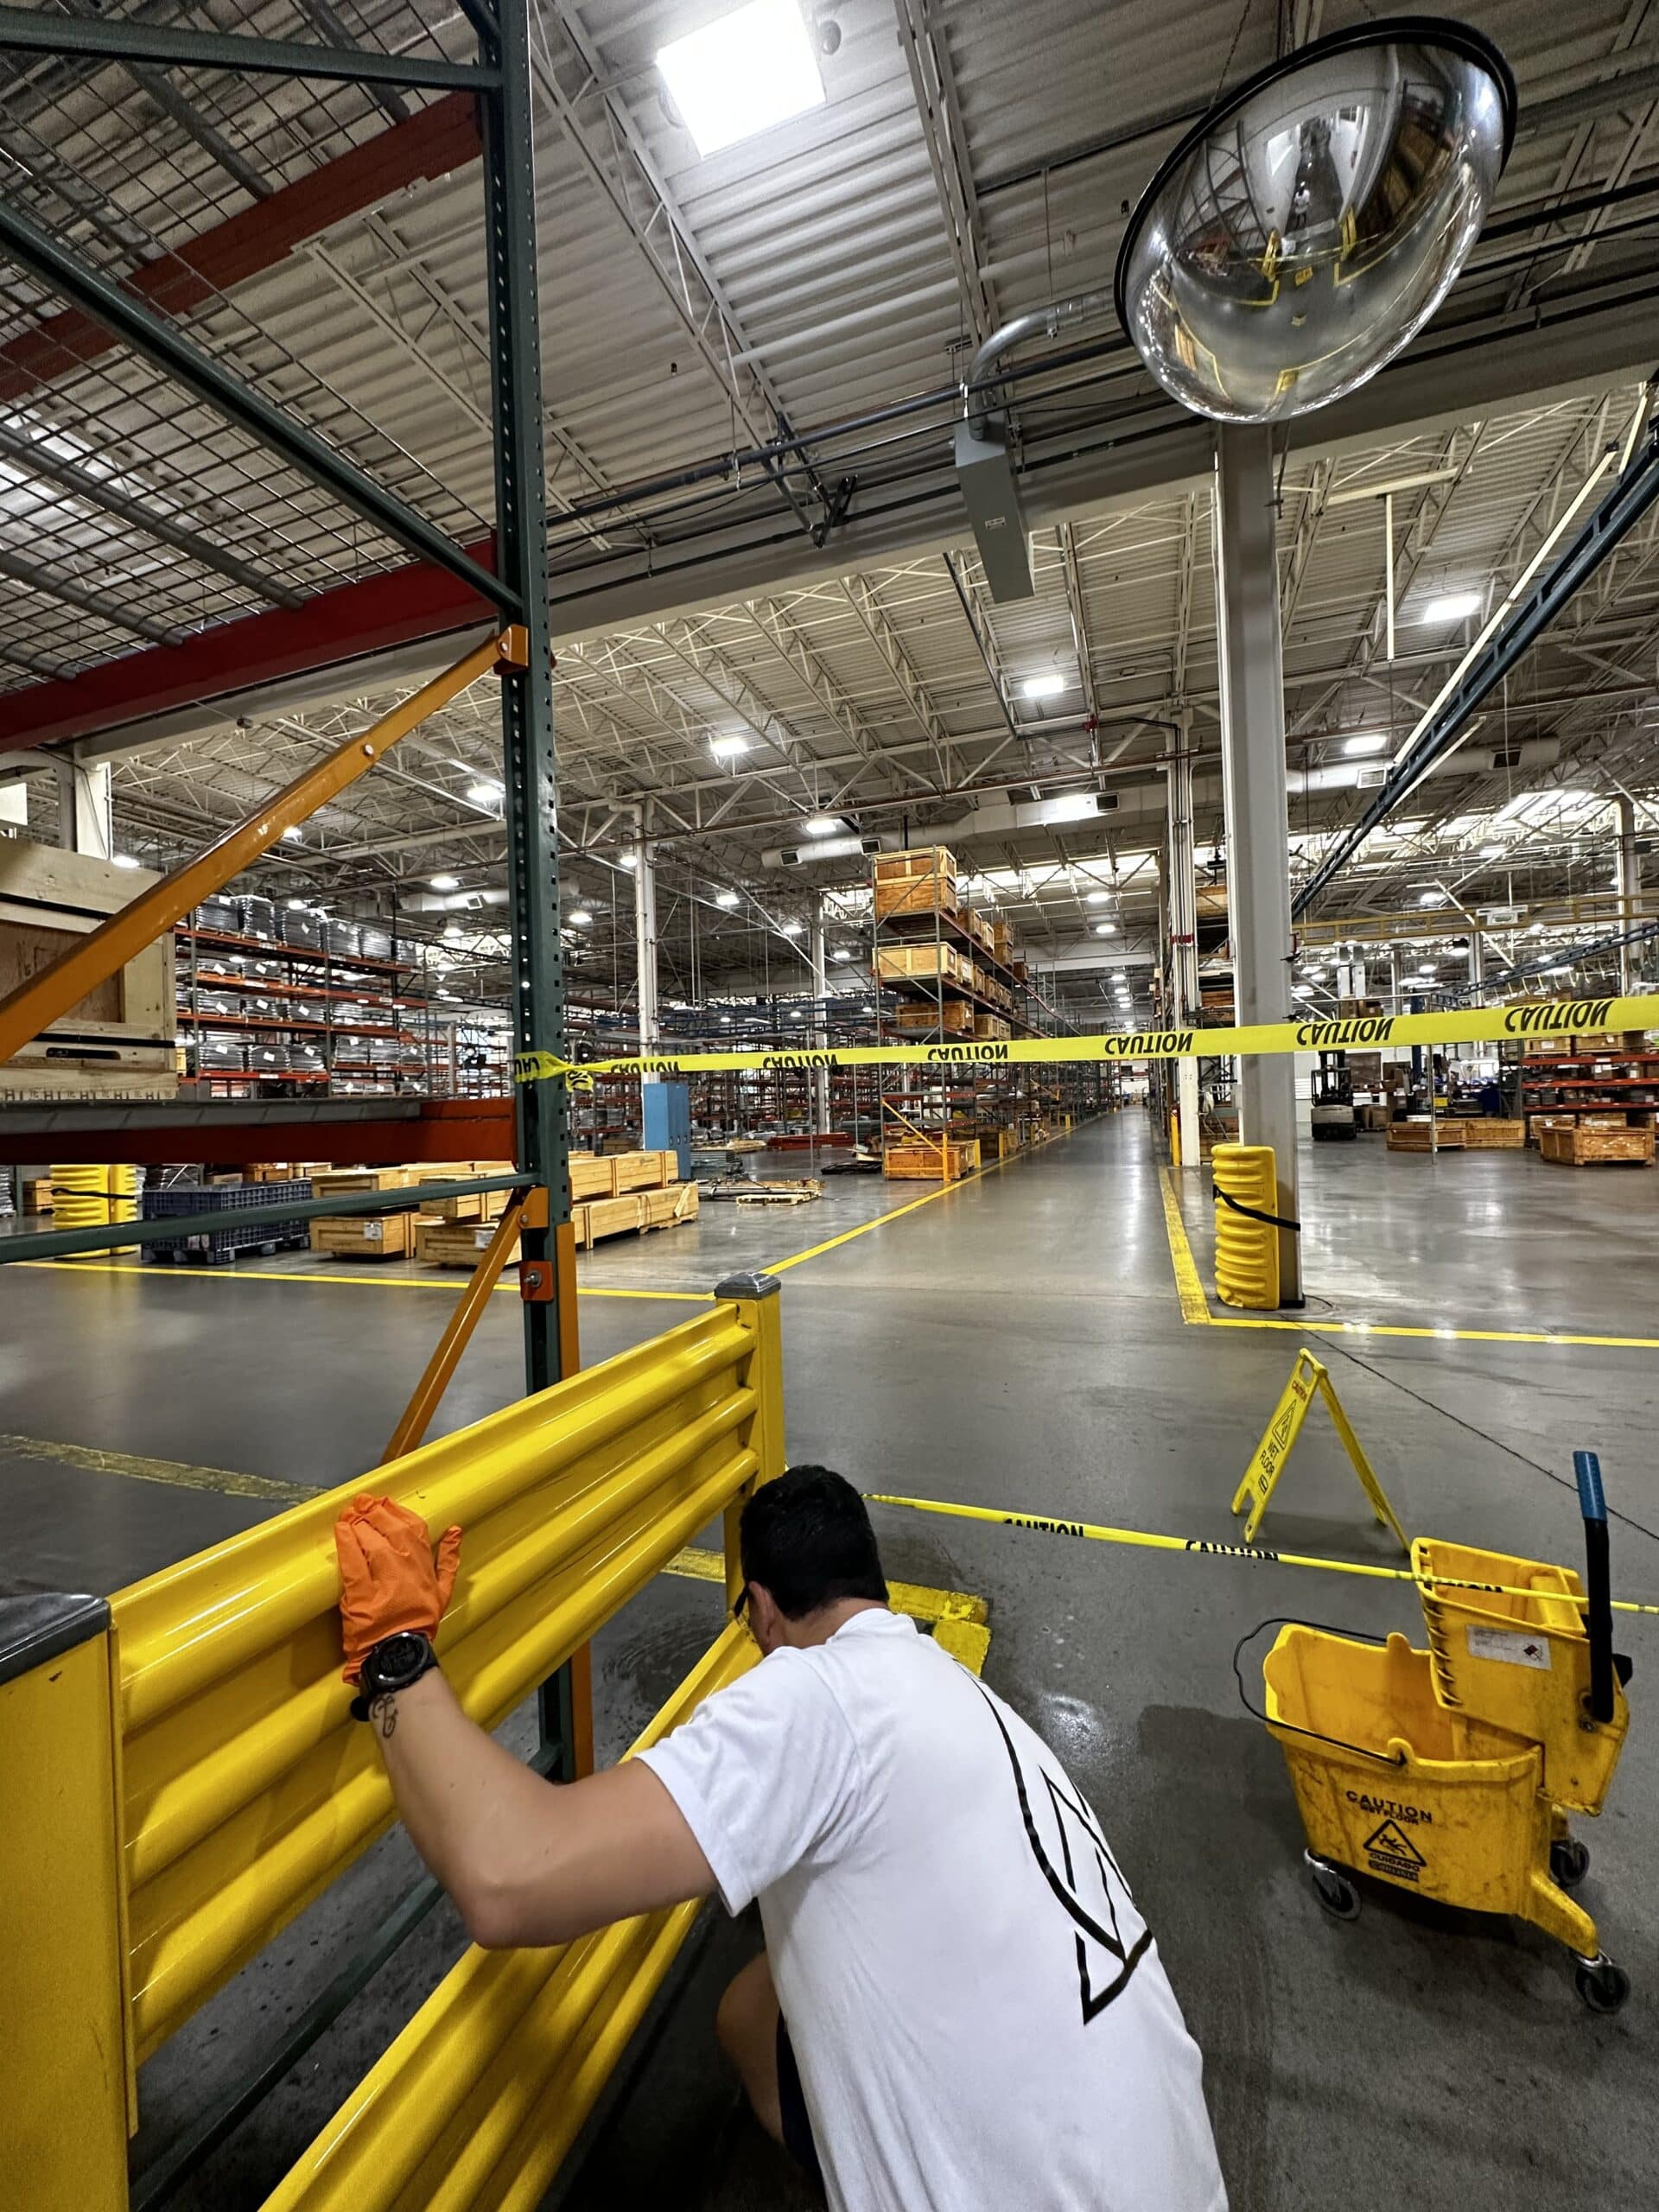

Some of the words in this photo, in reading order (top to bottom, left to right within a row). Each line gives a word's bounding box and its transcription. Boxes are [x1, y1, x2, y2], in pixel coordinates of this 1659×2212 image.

[1260, 1449, 1275, 1478] FLOOR
[1345, 1789, 1433, 1824] CAUTION
[1369, 1853, 1421, 1872] CUIDADO
